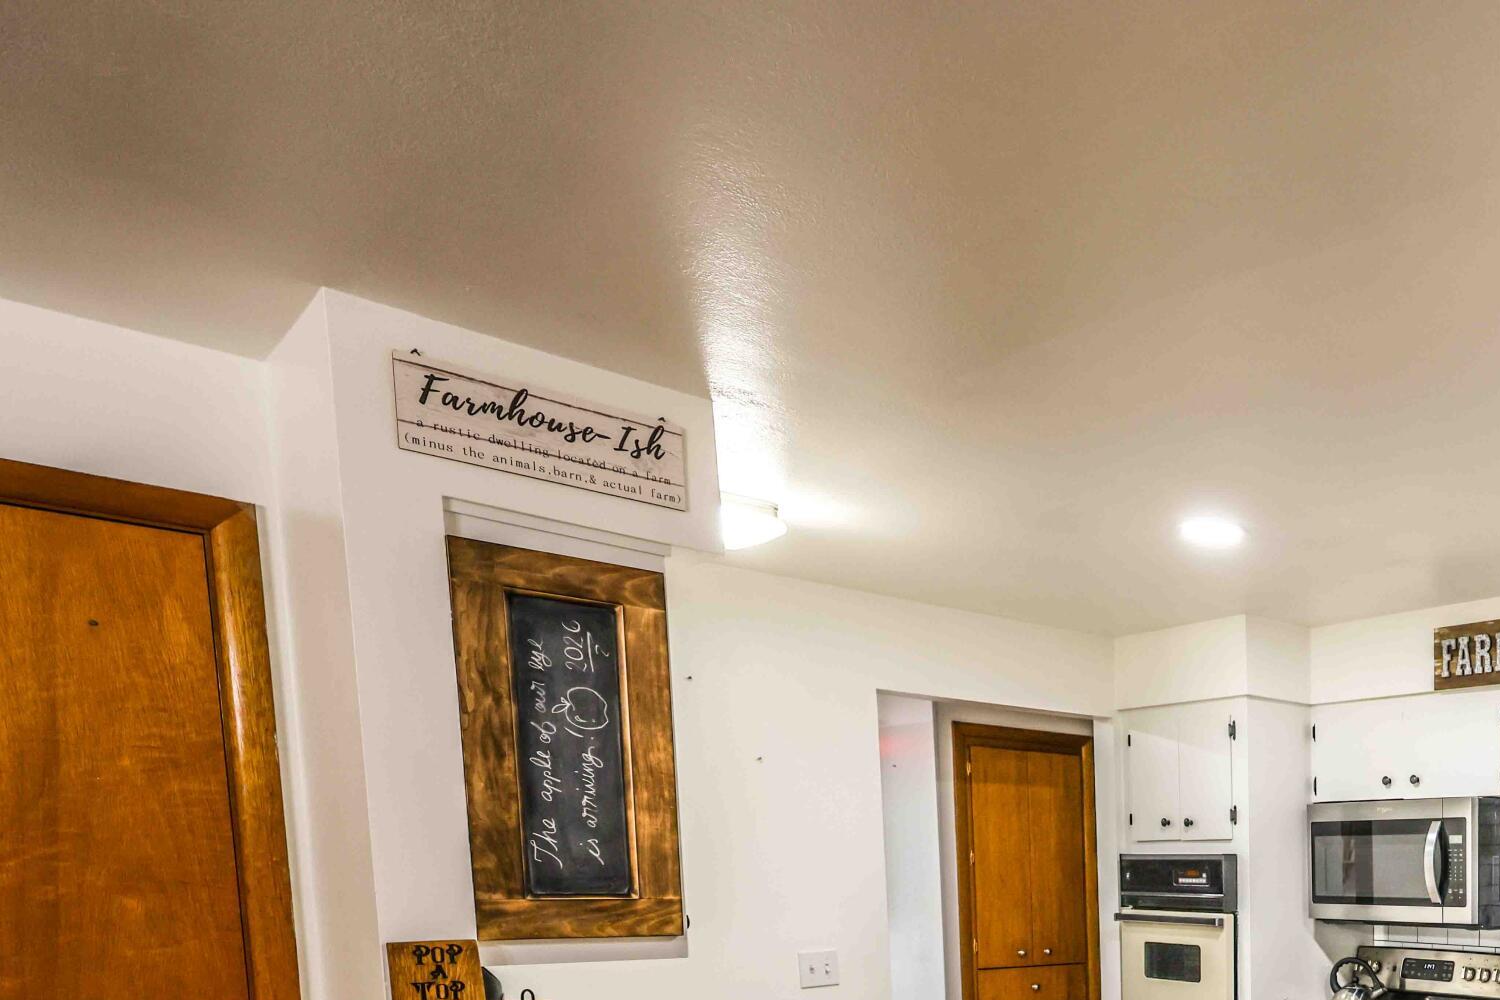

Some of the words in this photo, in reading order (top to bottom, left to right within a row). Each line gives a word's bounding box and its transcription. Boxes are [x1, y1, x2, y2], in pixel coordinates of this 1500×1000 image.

[418, 373, 668, 462] Farmhouse-Ish
[404, 431, 454, 453] (minus
[462, 446, 486, 460] the
[602, 481, 643, 496] actual
[650, 488, 682, 504] farm)
[433, 422, 481, 441] rustic
[488, 433, 550, 459] dwelling
[557, 449, 607, 470] located
[612, 465, 626, 475] on
[632, 469, 640, 478] a
[645, 471, 672, 486] farm
[526, 637, 552, 671] eye
[562, 619, 588, 672] 2026
[530, 681, 547, 714] our
[529, 720, 557, 744] of
[530, 750, 562, 802] apple
[529, 817, 563, 870] The
[579, 838, 605, 866] is
[412, 943, 464, 966] POP
[430, 964, 448, 979] A
